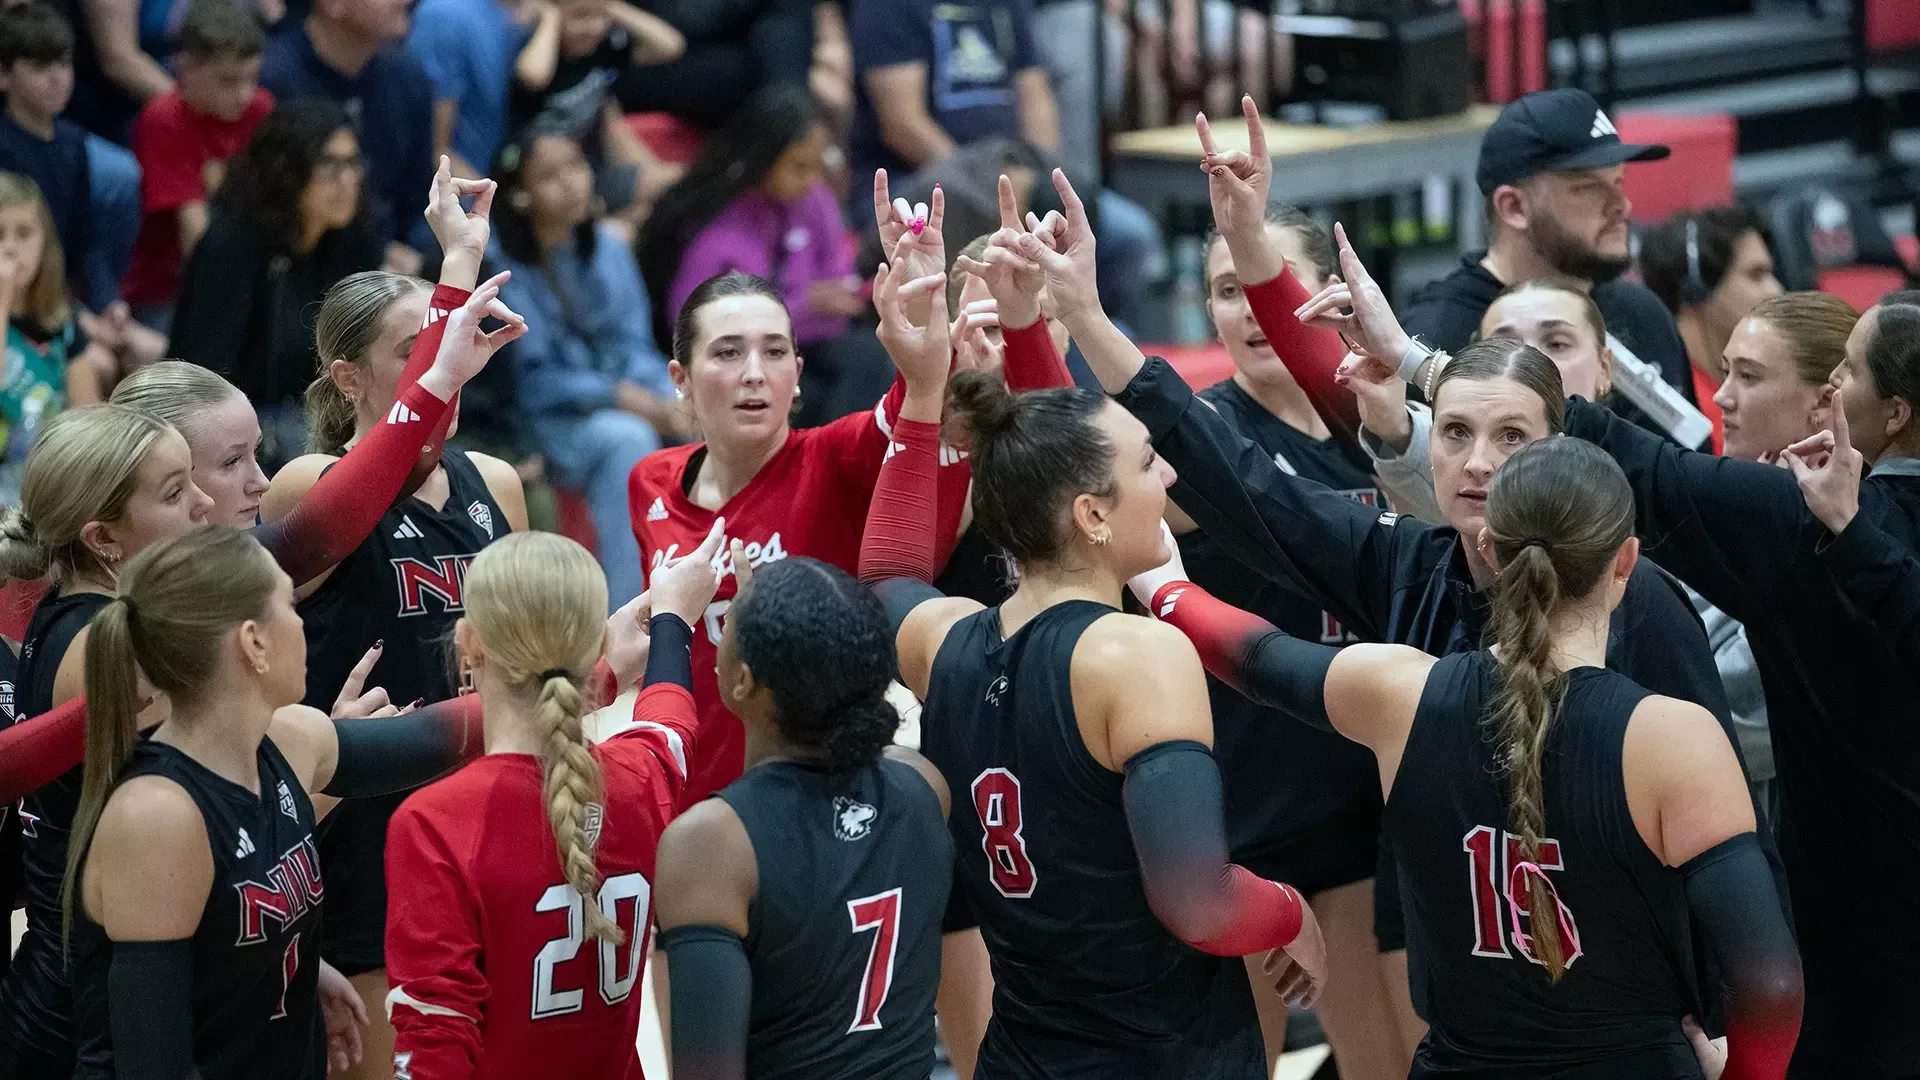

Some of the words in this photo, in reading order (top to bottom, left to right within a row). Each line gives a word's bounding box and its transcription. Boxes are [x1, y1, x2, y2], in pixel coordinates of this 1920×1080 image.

[971, 767, 1038, 898] 8
[1463, 825, 1582, 969] 15
[269, 931, 301, 1020] 1
[531, 872, 651, 1020] 20
[845, 887, 902, 1035] 7
